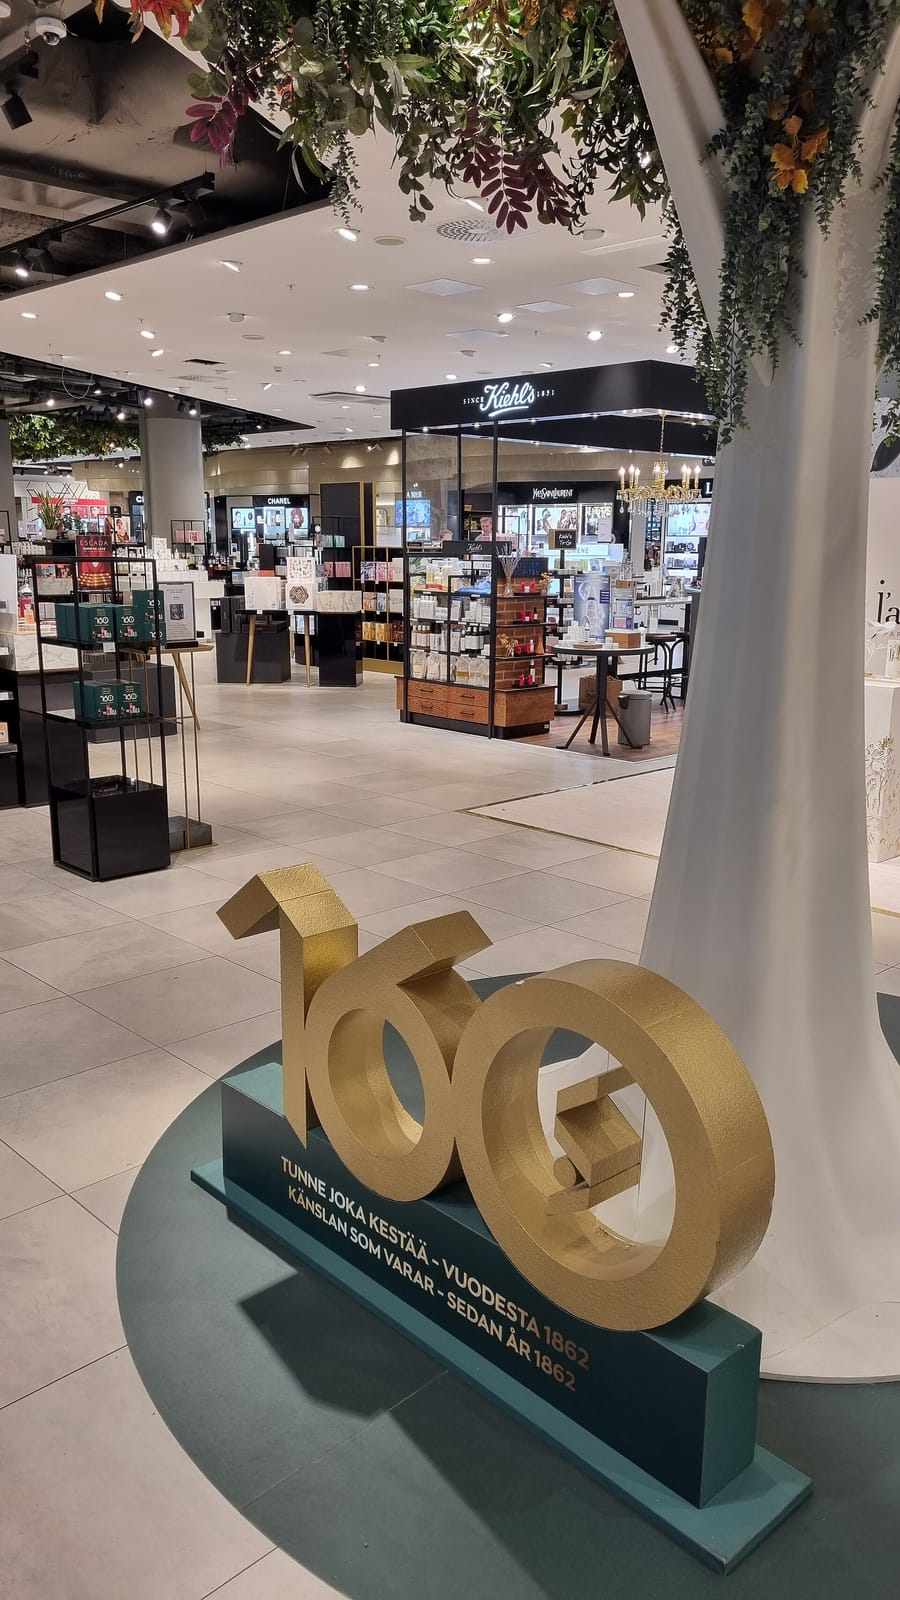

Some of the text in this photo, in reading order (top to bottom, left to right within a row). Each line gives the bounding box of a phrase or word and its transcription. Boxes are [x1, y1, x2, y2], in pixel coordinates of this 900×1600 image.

[463, 381, 555, 412] SINCE Kiehl's 1851
[79, 539, 109, 547] ESCADA
[267, 497, 291, 505] CHANEL
[216, 862, 775, 1331] 160
[280, 1155, 327, 1199] TUNNE
[328, 1187, 367, 1225] JOKA
[369, 1211, 430, 1266] KESTÄÄ
[441, 1258, 541, 1339] VUODESTA
[543, 1325, 590, 1371] 1862
[288, 1184, 348, 1237] KÄNSLAN
[349, 1226, 382, 1260] SOM
[383, 1247, 435, 1297] VARAR
[446, 1291, 503, 1343] SEDAN
[506, 1326, 532, 1362] ÅR
[534, 1350, 576, 1392] 1862
